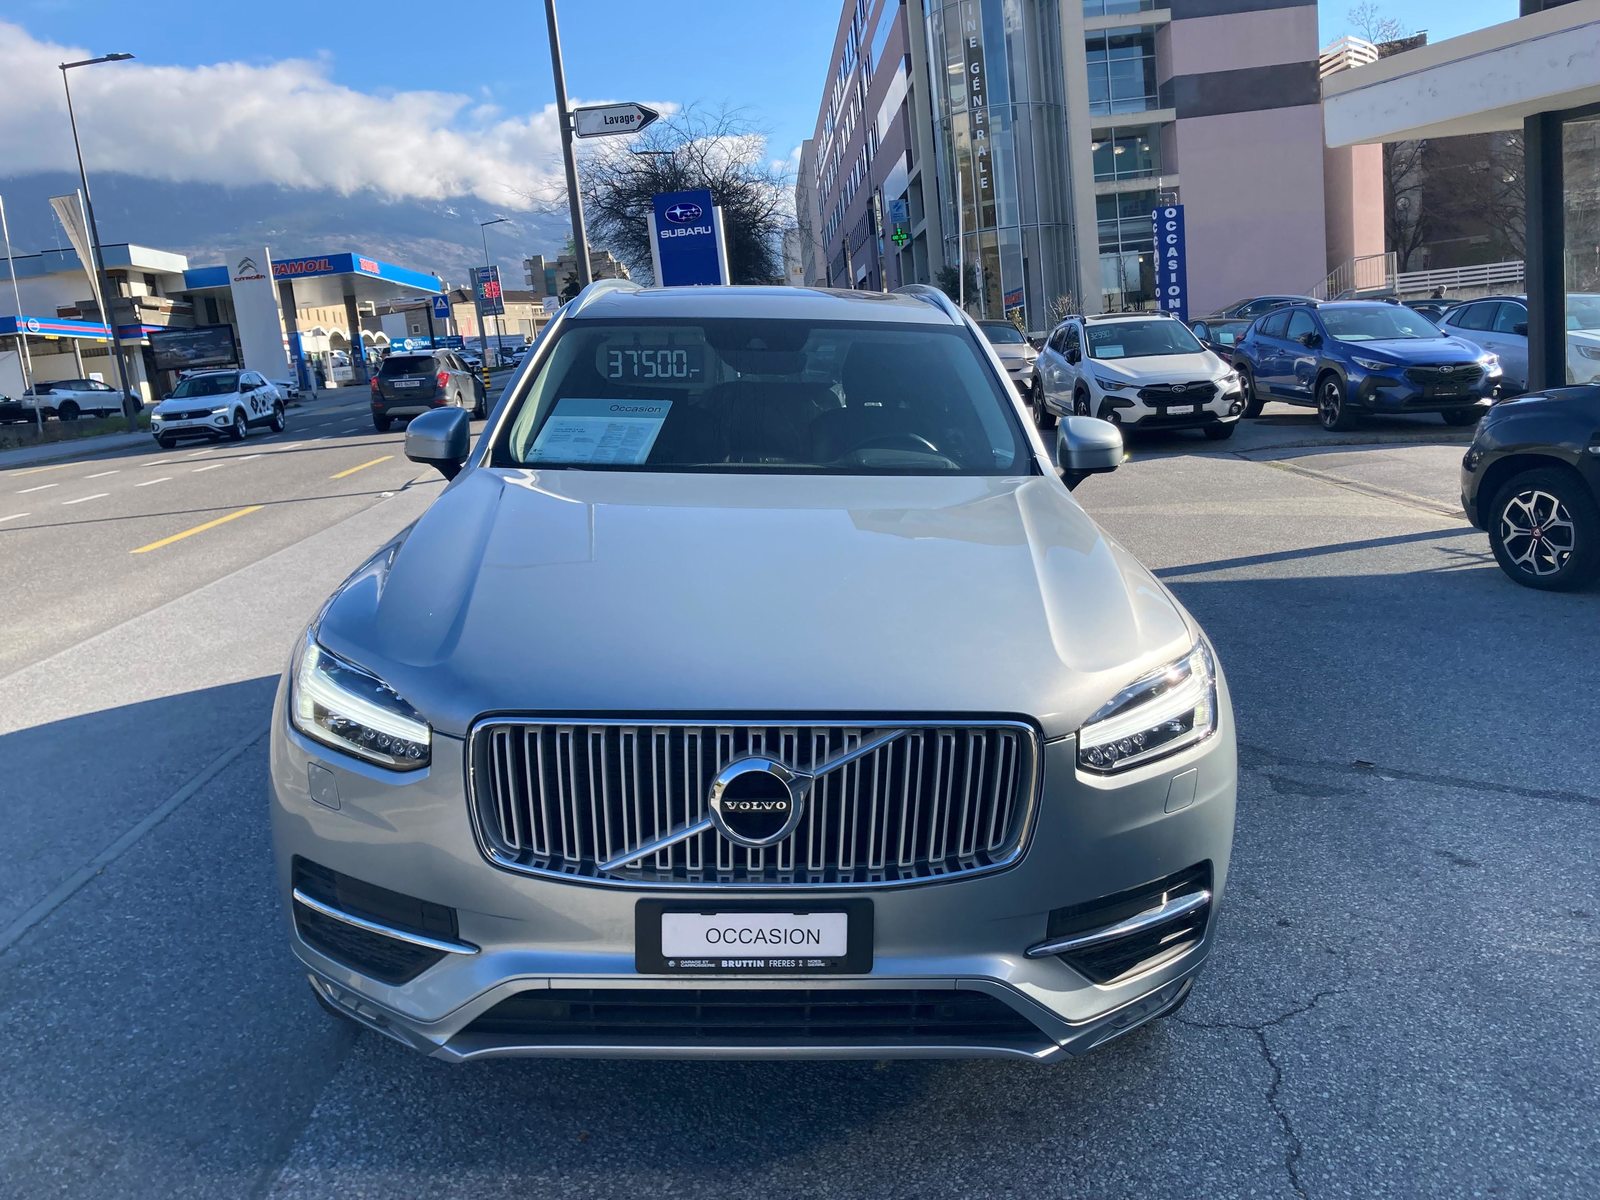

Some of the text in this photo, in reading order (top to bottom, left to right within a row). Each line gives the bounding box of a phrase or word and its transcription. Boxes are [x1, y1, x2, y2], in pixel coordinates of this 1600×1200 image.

[604, 113, 635, 125] Lavage
[969, 62, 989, 190] GÉNÉRALE
[660, 225, 712, 239] SUBARU
[271, 259, 334, 276] TAMOIL
[609, 404, 662, 413] Occasion
[725, 801, 787, 810] VOLVO
[705, 928, 821, 945] OCCASION
